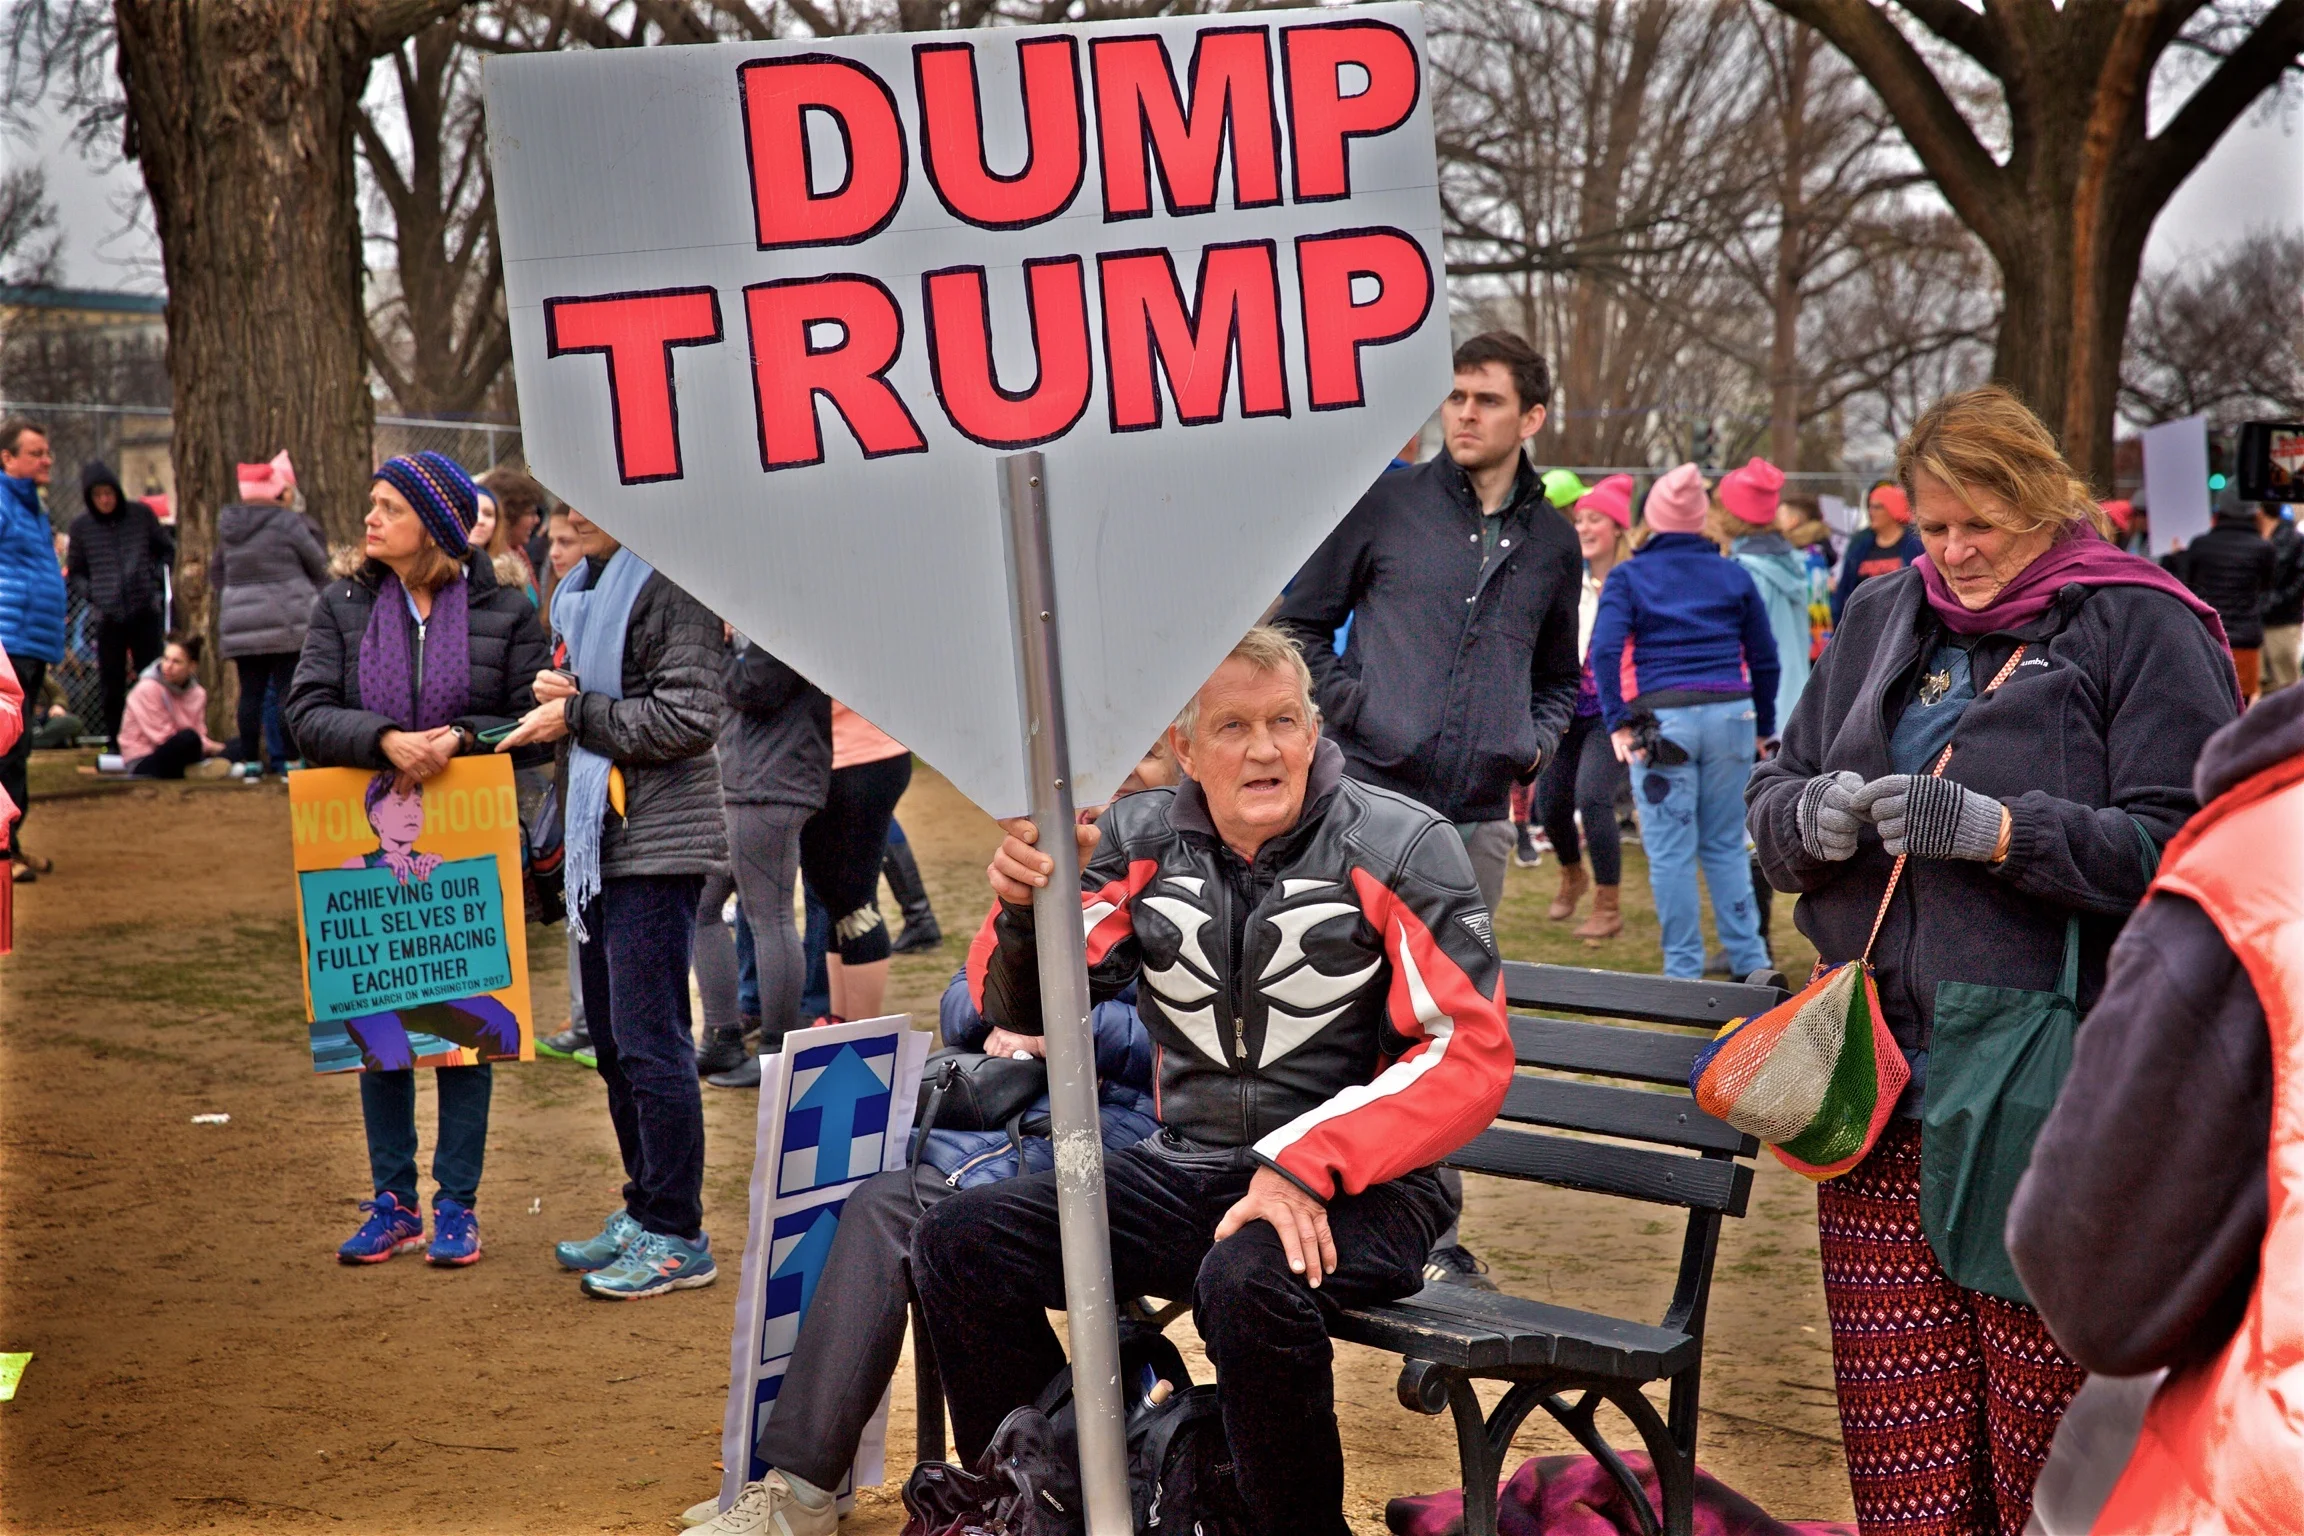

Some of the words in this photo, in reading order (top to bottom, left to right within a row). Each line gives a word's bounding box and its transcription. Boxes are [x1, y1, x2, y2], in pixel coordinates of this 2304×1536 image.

[738, 18, 1420, 251] DUMP
[544, 226, 1434, 486] TRUMP
[290, 785, 518, 846] WOMHOOD
[326, 882, 433, 914] ACHIEVING
[442, 877, 480, 899] OUR
[321, 916, 373, 942] FULL
[381, 907, 456, 934] SELVES
[464, 901, 488, 924] BY
[317, 944, 380, 972] FULLY
[390, 927, 496, 961] EMBRACING
[352, 958, 468, 995] EACHOTHER
[372, 993, 402, 1007] MARCH
[405, 990, 418, 1001] ON
[422, 979, 481, 998] WASHINGTON
[484, 974, 505, 987] 2017
